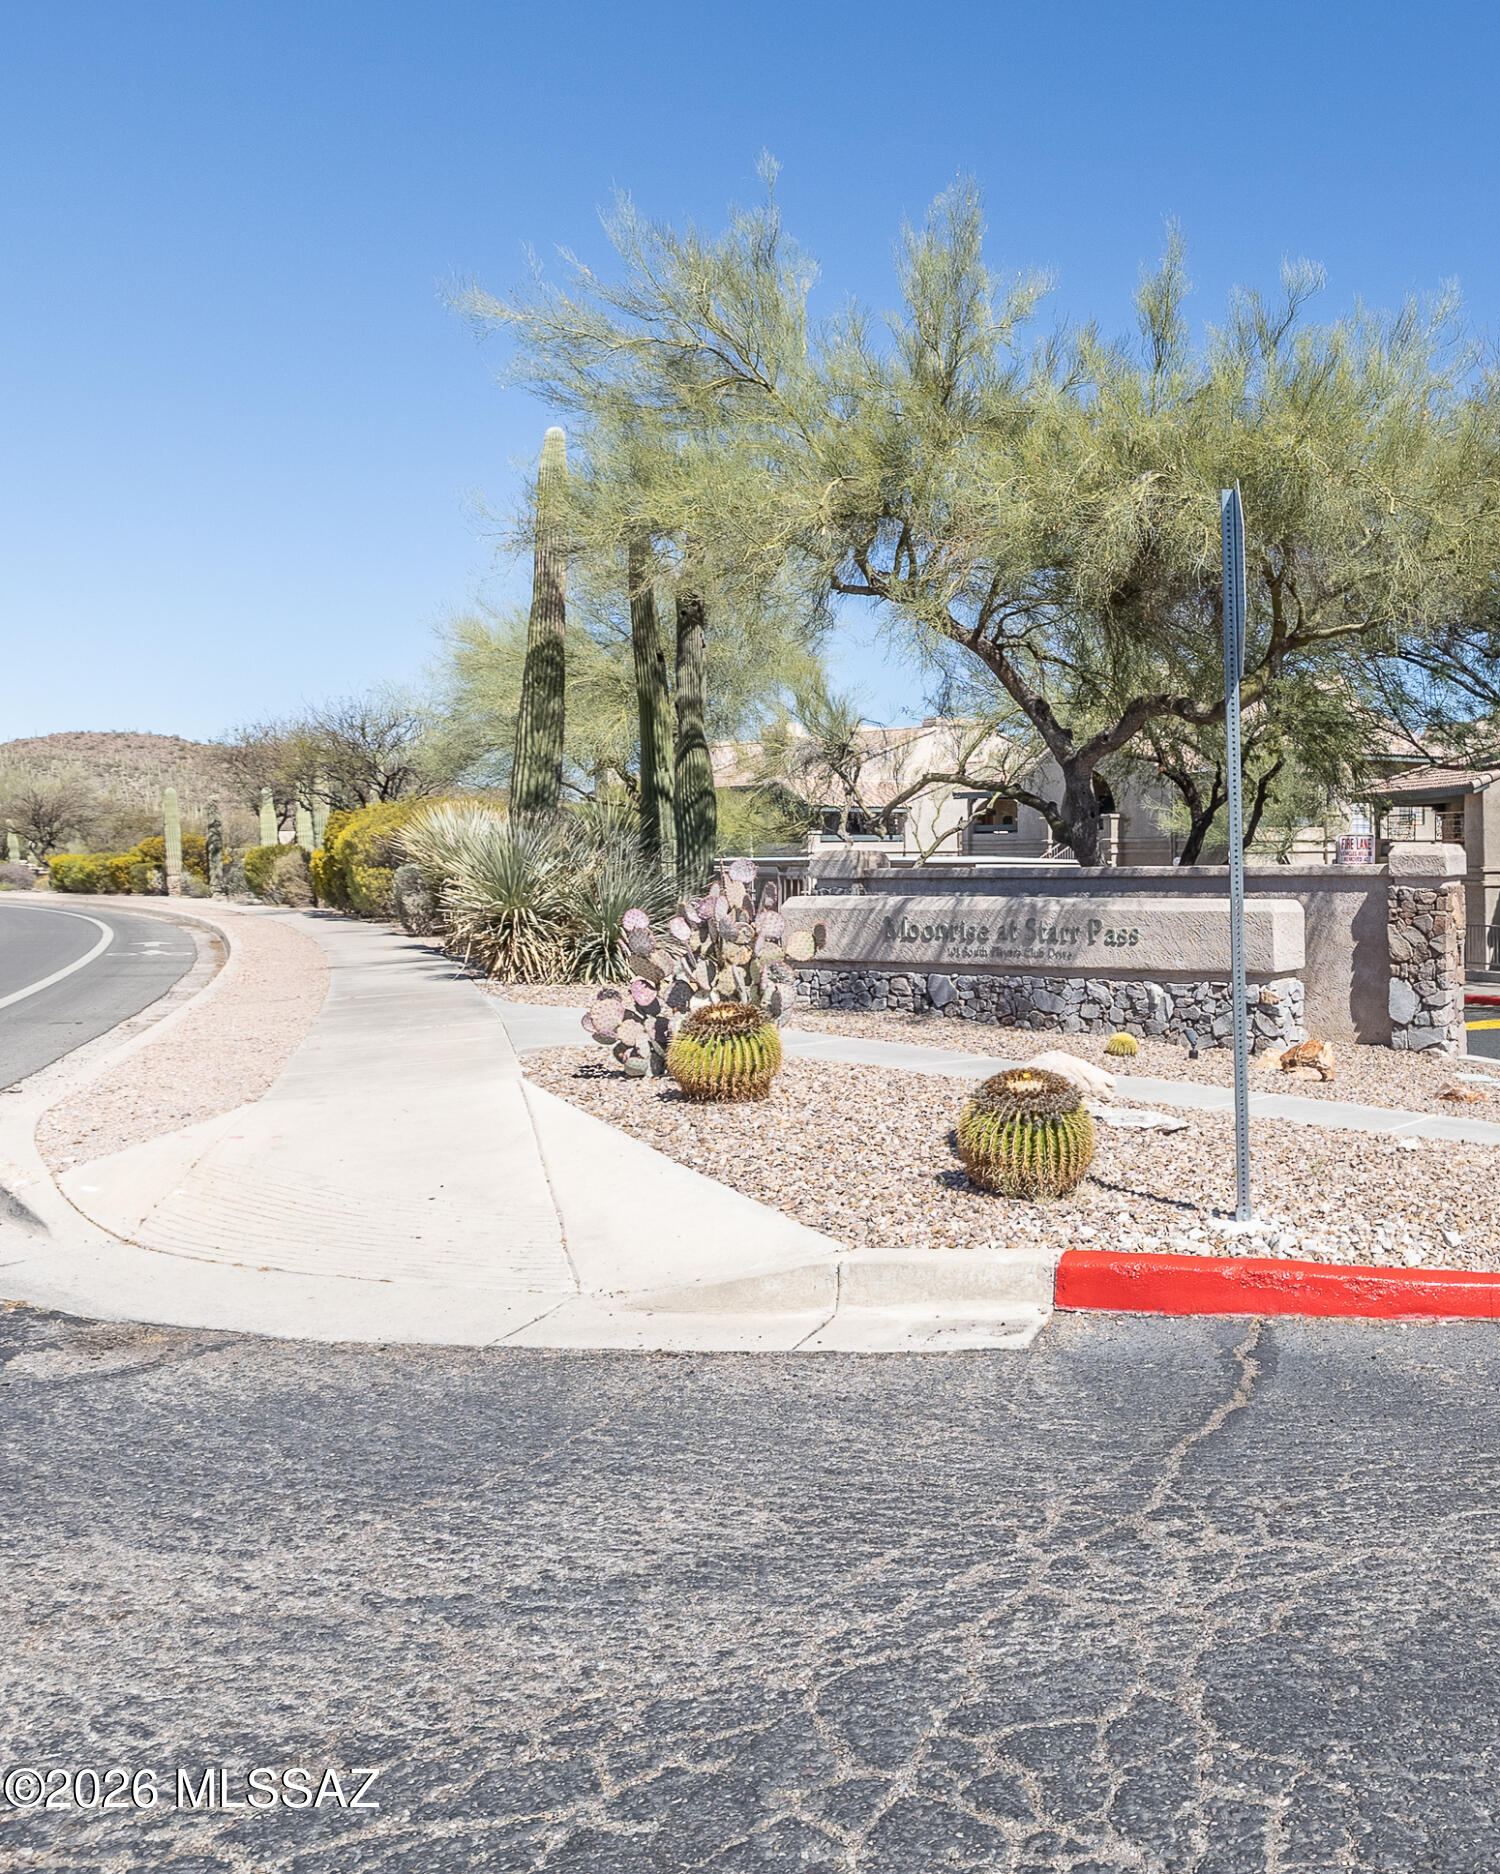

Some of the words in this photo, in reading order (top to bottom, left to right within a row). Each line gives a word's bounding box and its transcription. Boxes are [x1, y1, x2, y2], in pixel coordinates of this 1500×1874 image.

[1341, 838, 1354, 850] FIRE
[1356, 838, 1372, 850] LANE
[882, 915, 990, 946] Moonrise
[996, 918, 1017, 945] at
[1020, 917, 1081, 947] Starr
[1086, 918, 1140, 948] Pass
